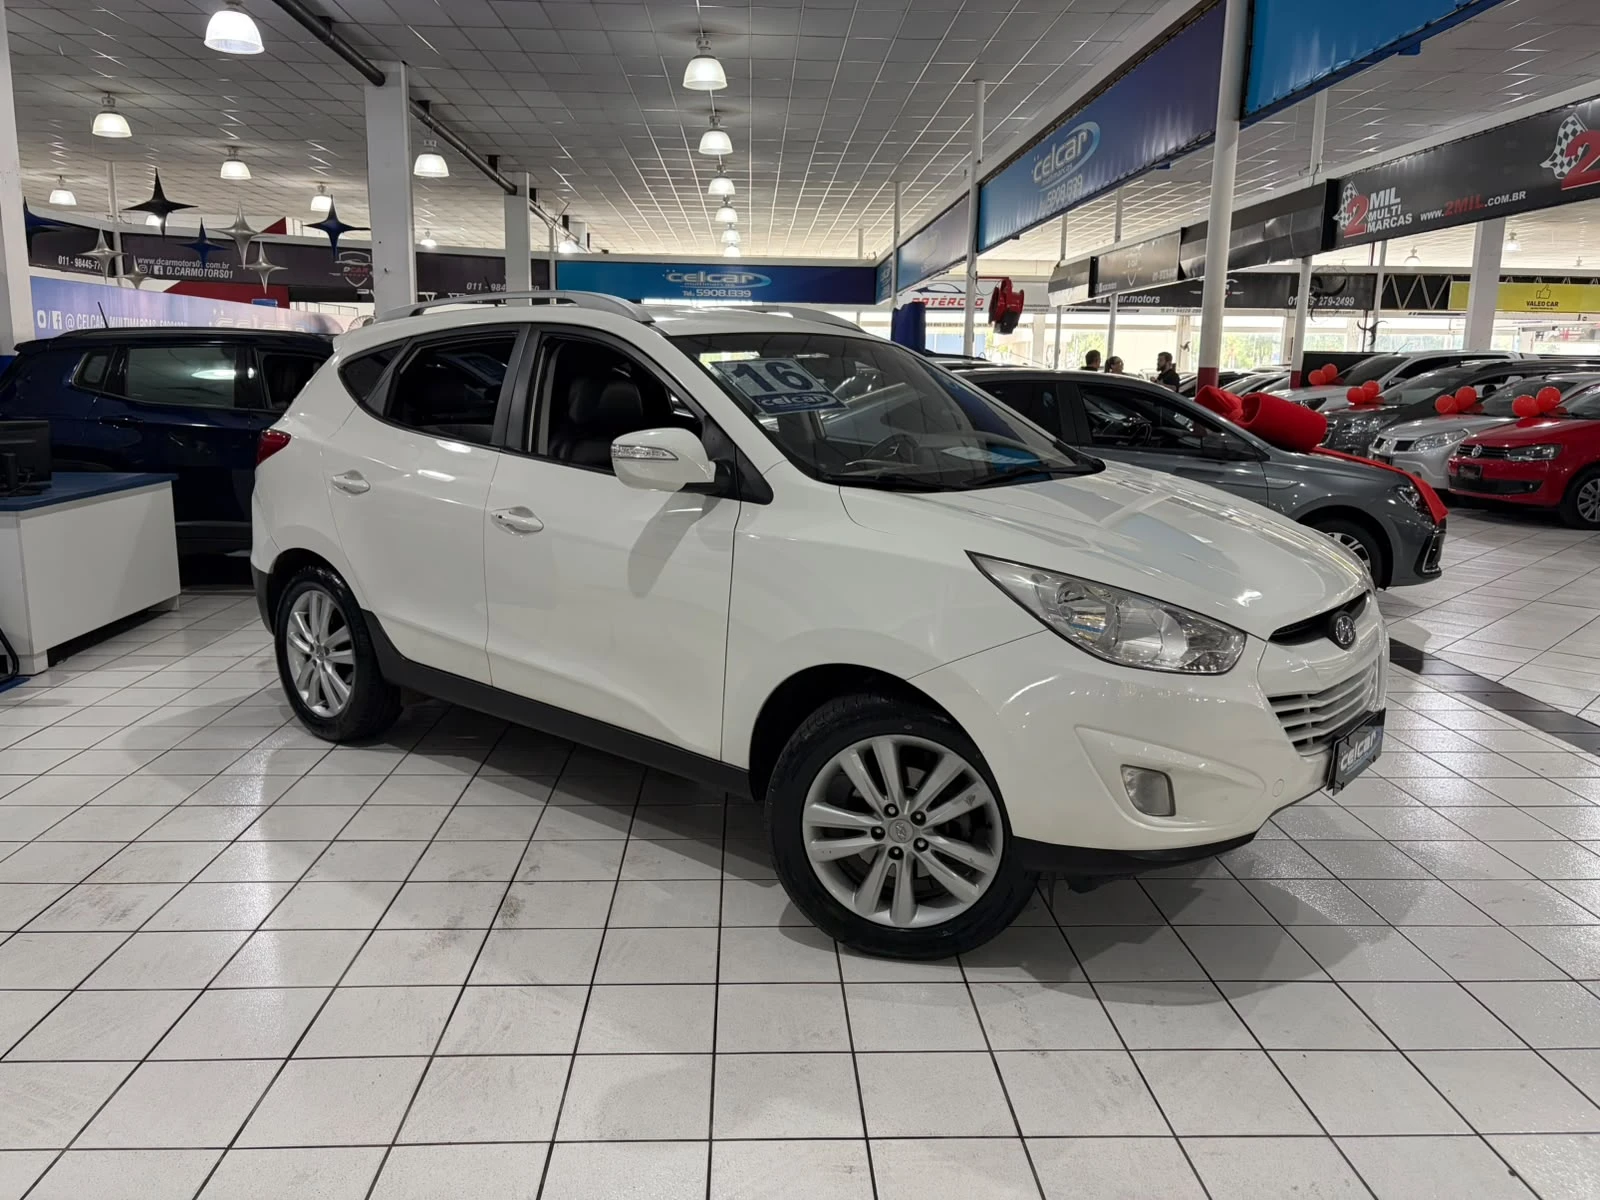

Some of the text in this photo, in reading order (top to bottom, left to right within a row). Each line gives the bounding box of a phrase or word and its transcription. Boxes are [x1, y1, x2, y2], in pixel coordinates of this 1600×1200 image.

[1033, 131, 1087, 183] celcar
[1369, 186, 1401, 209] MIL
[1420, 190, 1527, 222] www.2MIL.COM.BR
[1344, 195, 1370, 239] 2
[1366, 212, 1413, 233] MARCAS
[1368, 204, 1402, 223] MULTI
[58, 255, 70, 266] 011
[74, 257, 104, 271] 98445-77
[137, 257, 230, 269] www.dcarmotors01com.br
[166, 266, 234, 279] D.CARMOTORS01
[466, 281, 482, 291] 011
[667, 271, 754, 284] celcar
[731, 361, 814, 392] 16
[761, 394, 827, 406] celcar
[1340, 729, 1377, 772] celcar
